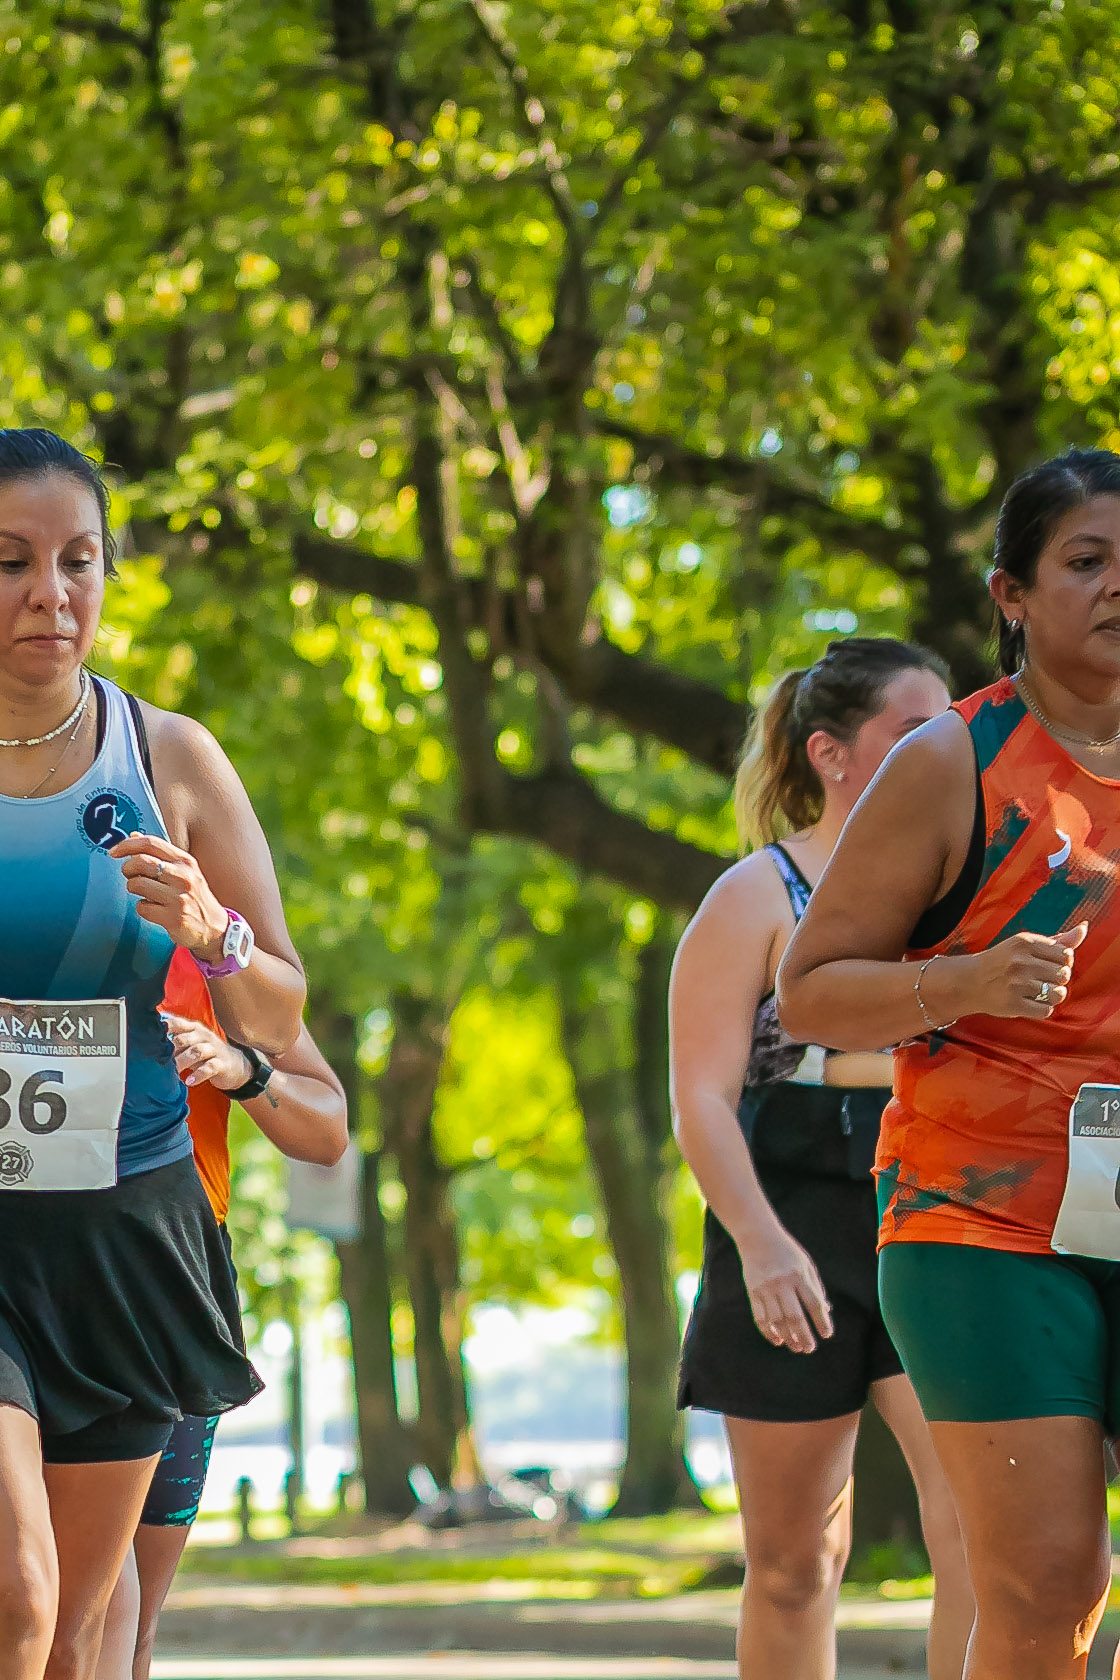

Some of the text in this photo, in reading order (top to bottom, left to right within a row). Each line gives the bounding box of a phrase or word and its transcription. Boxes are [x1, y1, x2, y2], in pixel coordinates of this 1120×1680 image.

[23, 1042, 78, 1056] VOLUNTARIOS
[79, 1044, 117, 1056] ROSARIO
[1, 1154, 21, 1170] 27
